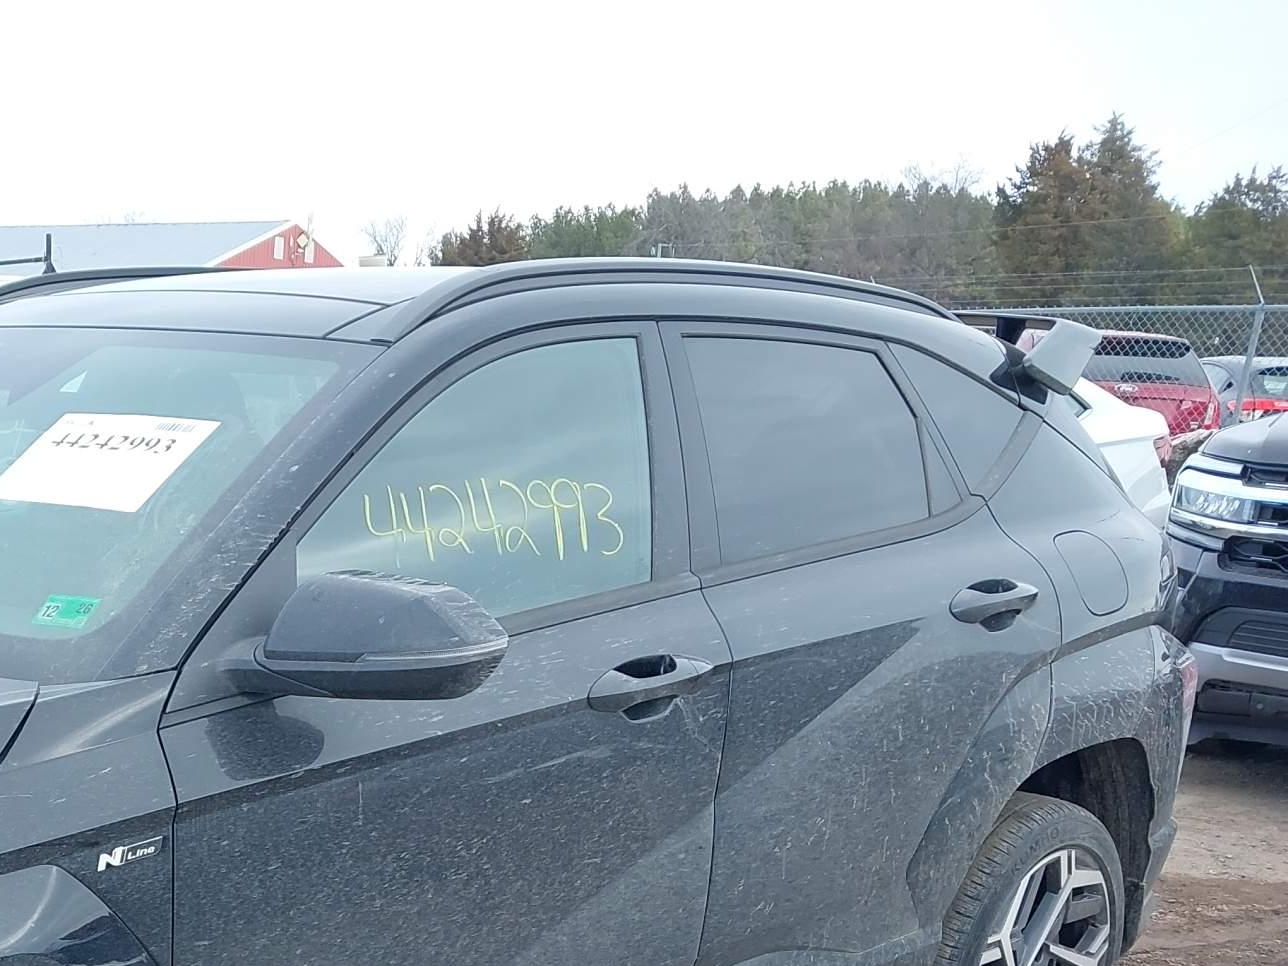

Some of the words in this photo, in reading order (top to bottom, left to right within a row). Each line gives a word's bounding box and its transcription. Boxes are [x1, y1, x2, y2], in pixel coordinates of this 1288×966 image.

[52, 433, 177, 454] 44242993
[364, 478, 624, 562] 44242993
[42, 605, 60, 618] 12
[97, 846, 123, 872] N
